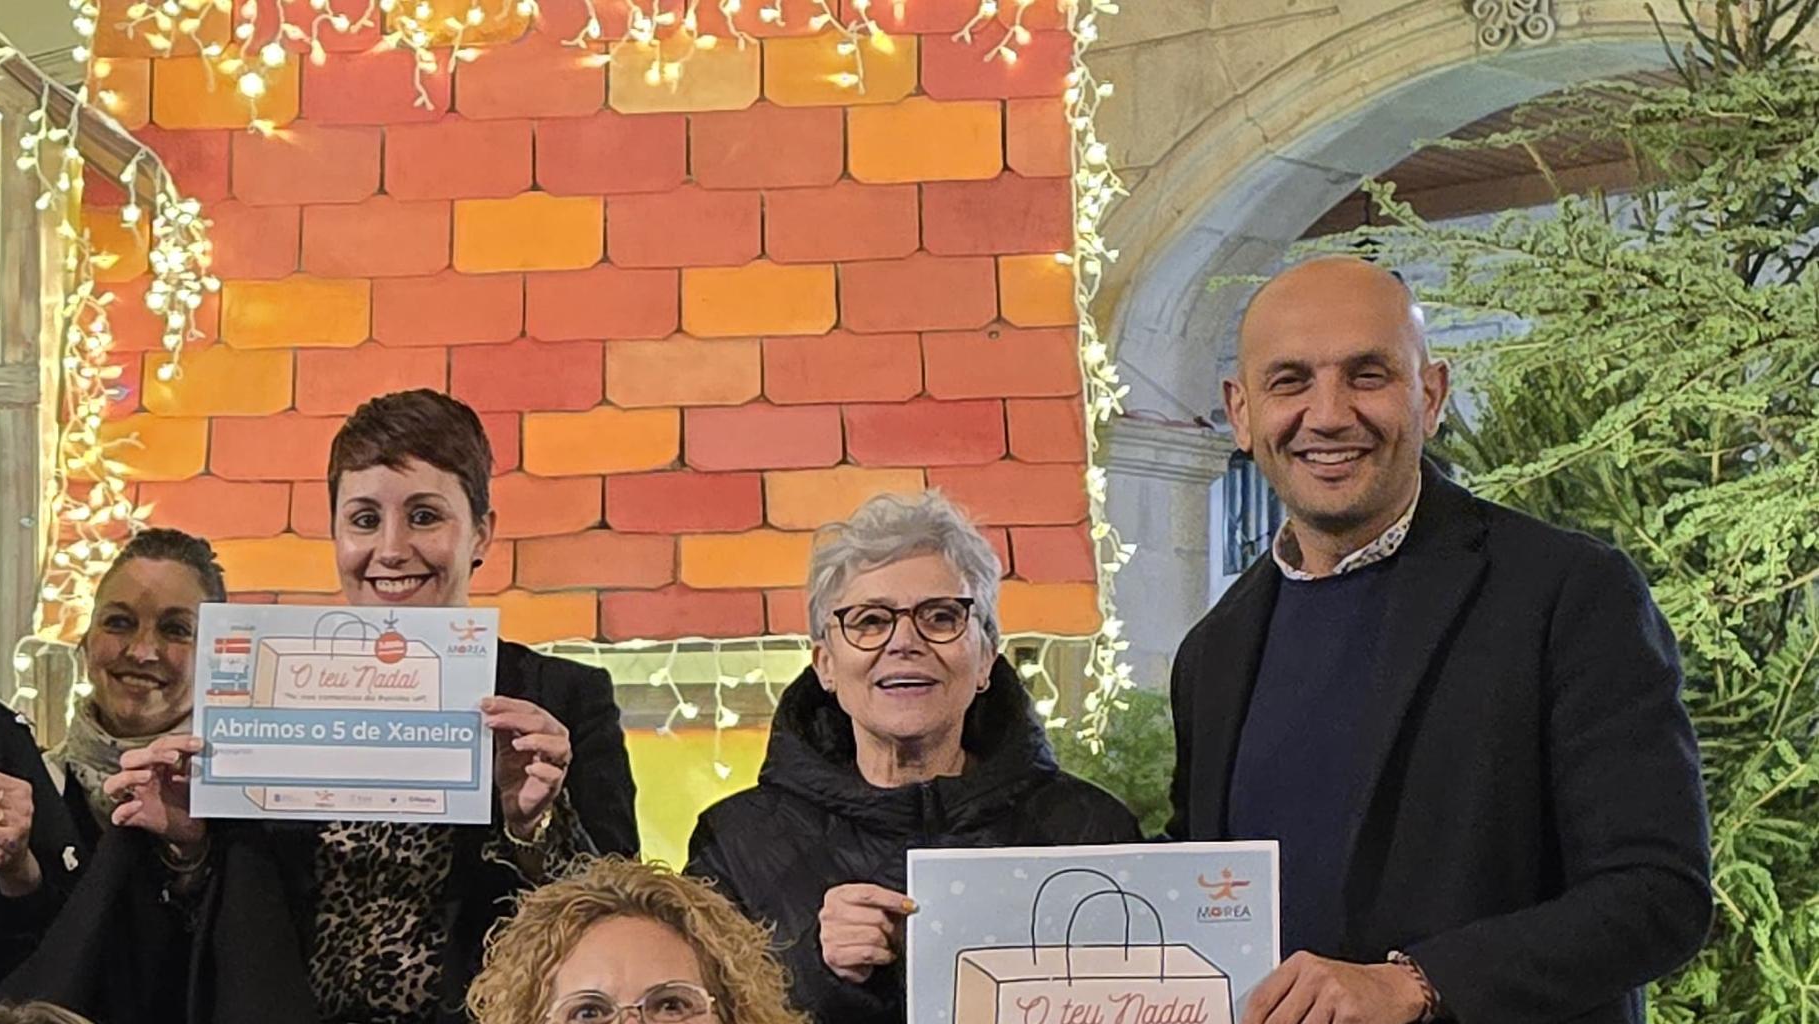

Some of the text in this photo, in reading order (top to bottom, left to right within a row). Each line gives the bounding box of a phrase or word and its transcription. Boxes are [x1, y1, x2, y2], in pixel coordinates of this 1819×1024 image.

[291, 664, 419, 693] O teu Nadal
[212, 718, 474, 742] Abrimos o 5 de Xaneiro
[1197, 906, 1251, 918] MOREA
